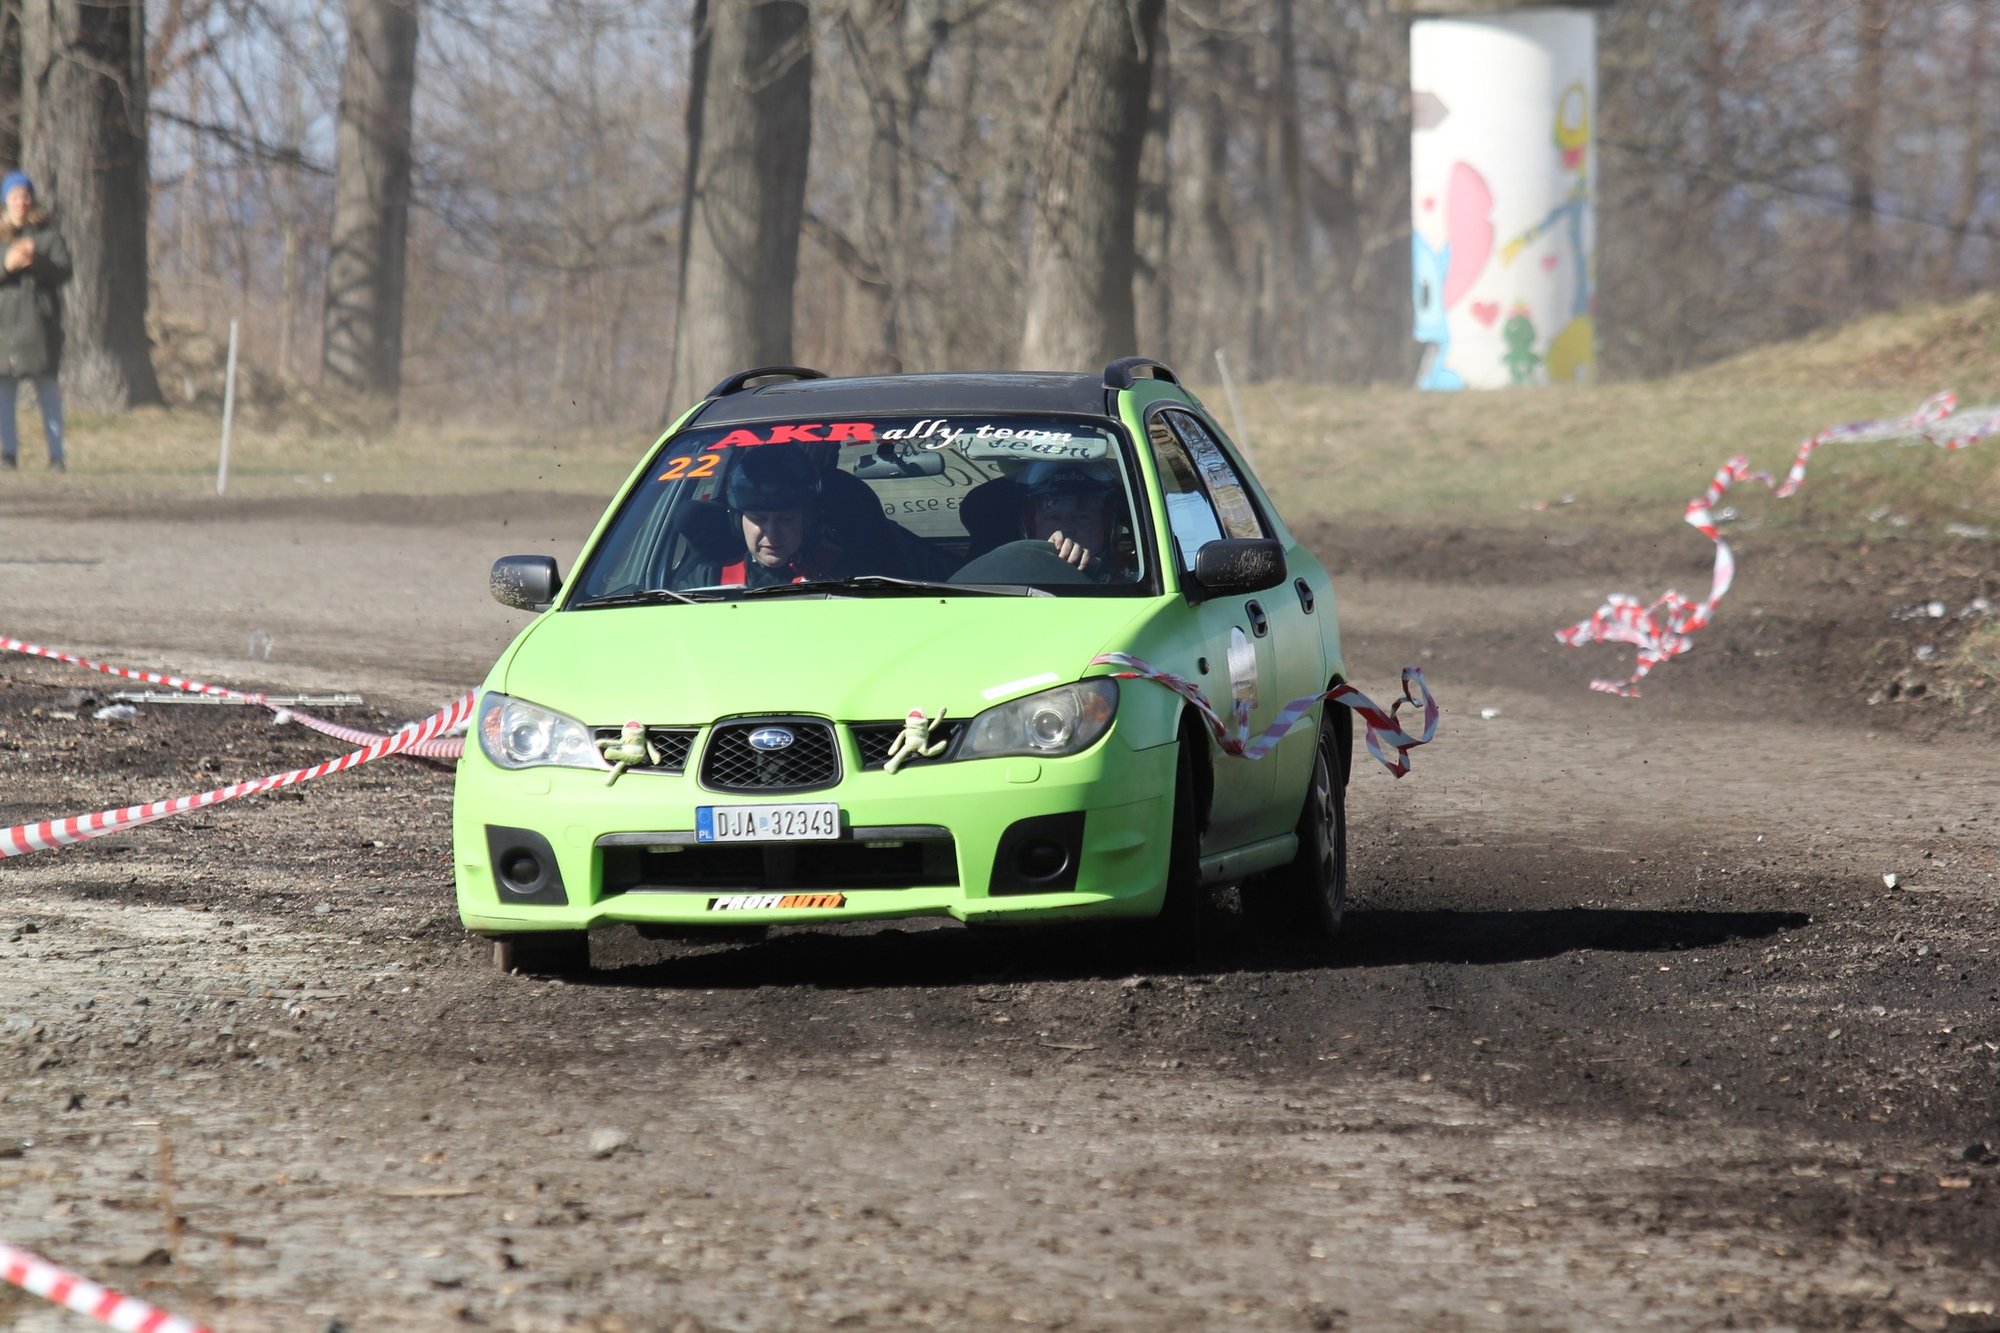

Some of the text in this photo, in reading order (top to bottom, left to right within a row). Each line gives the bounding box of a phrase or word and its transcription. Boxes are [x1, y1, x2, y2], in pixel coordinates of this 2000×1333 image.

[976, 424, 1072, 442] team
[657, 454, 721, 482] 22
[698, 830, 712, 839] PL
[717, 810, 834, 837] DJA 32349
